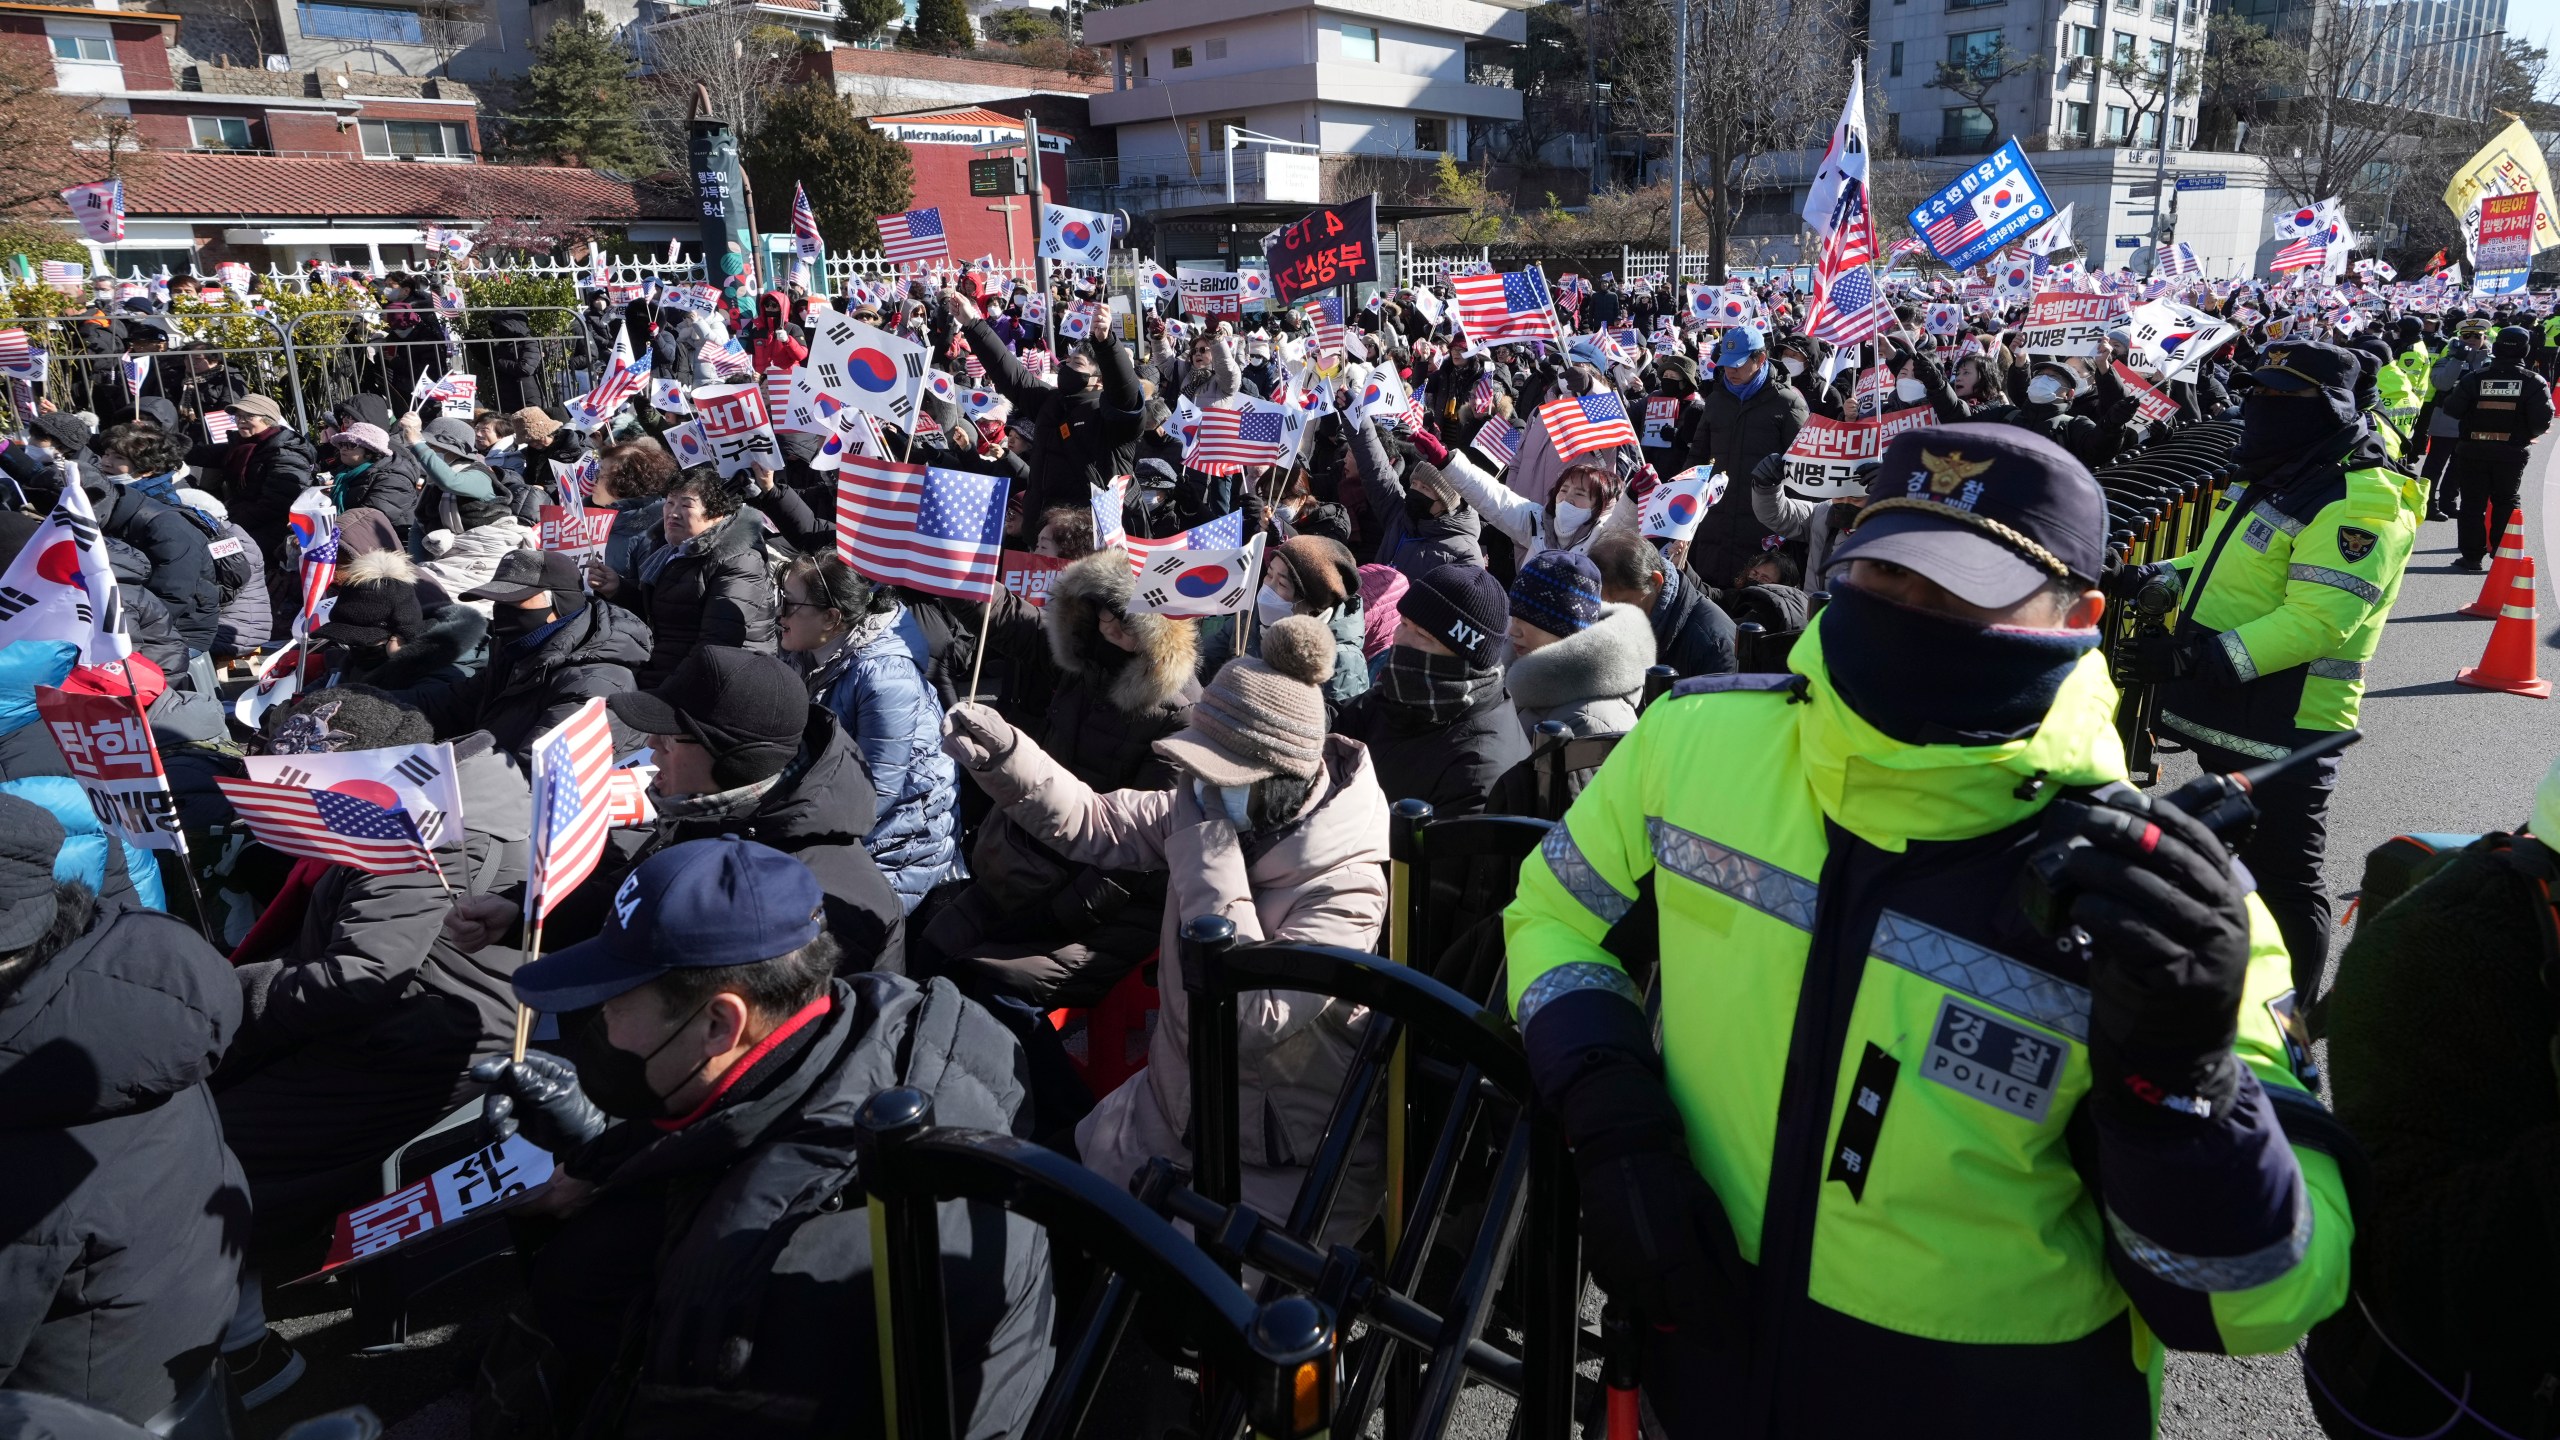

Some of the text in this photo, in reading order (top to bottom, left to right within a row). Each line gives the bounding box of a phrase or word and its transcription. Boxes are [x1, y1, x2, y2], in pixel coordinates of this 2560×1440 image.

[897, 125, 982, 143] International
[1038, 136, 1059, 149] hurch
[698, 171, 728, 184] 행복이
[700, 186, 730, 198] 가득한
[702, 201, 726, 218] 용산
[2490, 196, 2528, 214] 재명아!
[1200, 276, 1239, 293] 이재명
[1182, 294, 1239, 314] 탄핵반대
[2026, 298, 2110, 327] 탄핵반대
[2068, 325, 2104, 345] 구속
[1856, 368, 1894, 393] 탄핵반
[445, 400, 472, 412] 구속
[720, 433, 774, 462] 구속
[1907, 471, 1985, 505] 경 찰
[213, 540, 239, 556] 부정선거
[2244, 533, 2265, 550] POLICE
[1448, 619, 1486, 651] NY
[51, 717, 154, 775] 탄핵
[1934, 1054, 2038, 1110] POLICE
